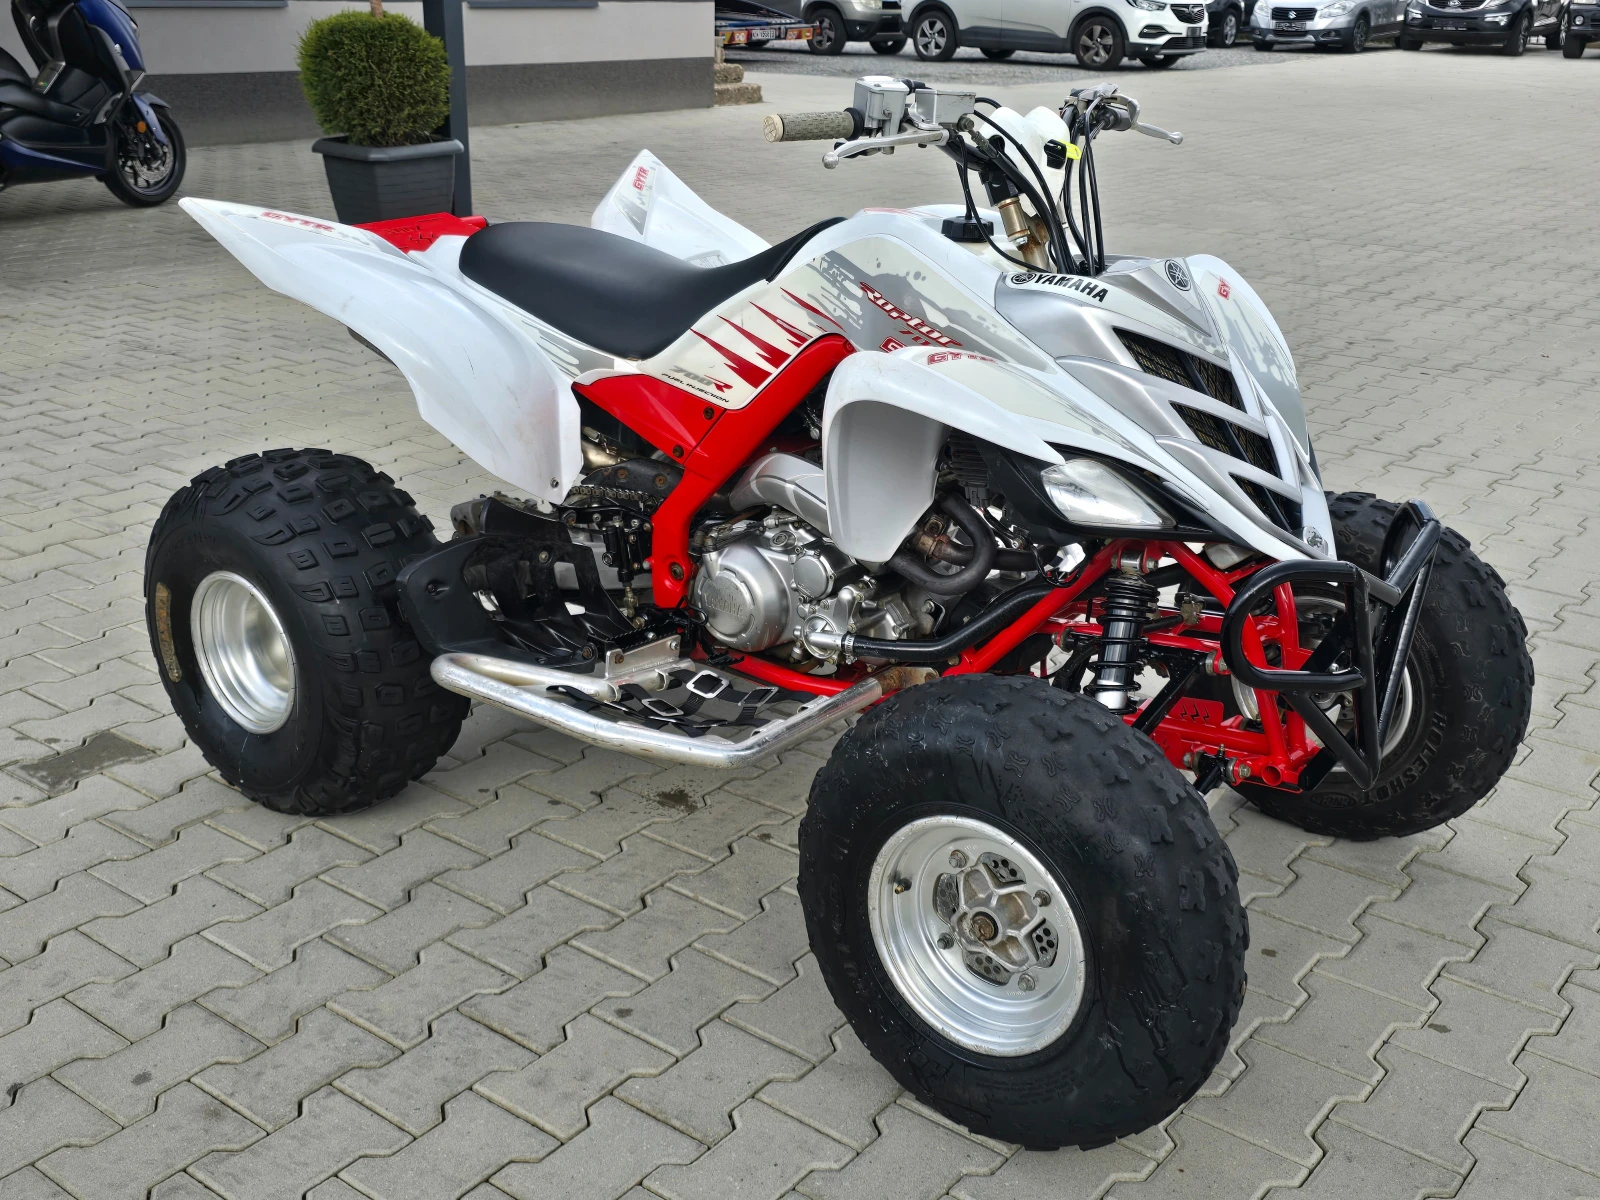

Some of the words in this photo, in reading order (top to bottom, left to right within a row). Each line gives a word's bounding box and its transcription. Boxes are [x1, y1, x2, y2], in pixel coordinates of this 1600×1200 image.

[1034, 273, 1109, 303] YAMAHA
[661, 373, 685, 385] FUEL
[686, 383, 730, 403] INJECTION
[668, 365, 734, 394] 700R
[1362, 711, 1448, 806] HOLESHOT
